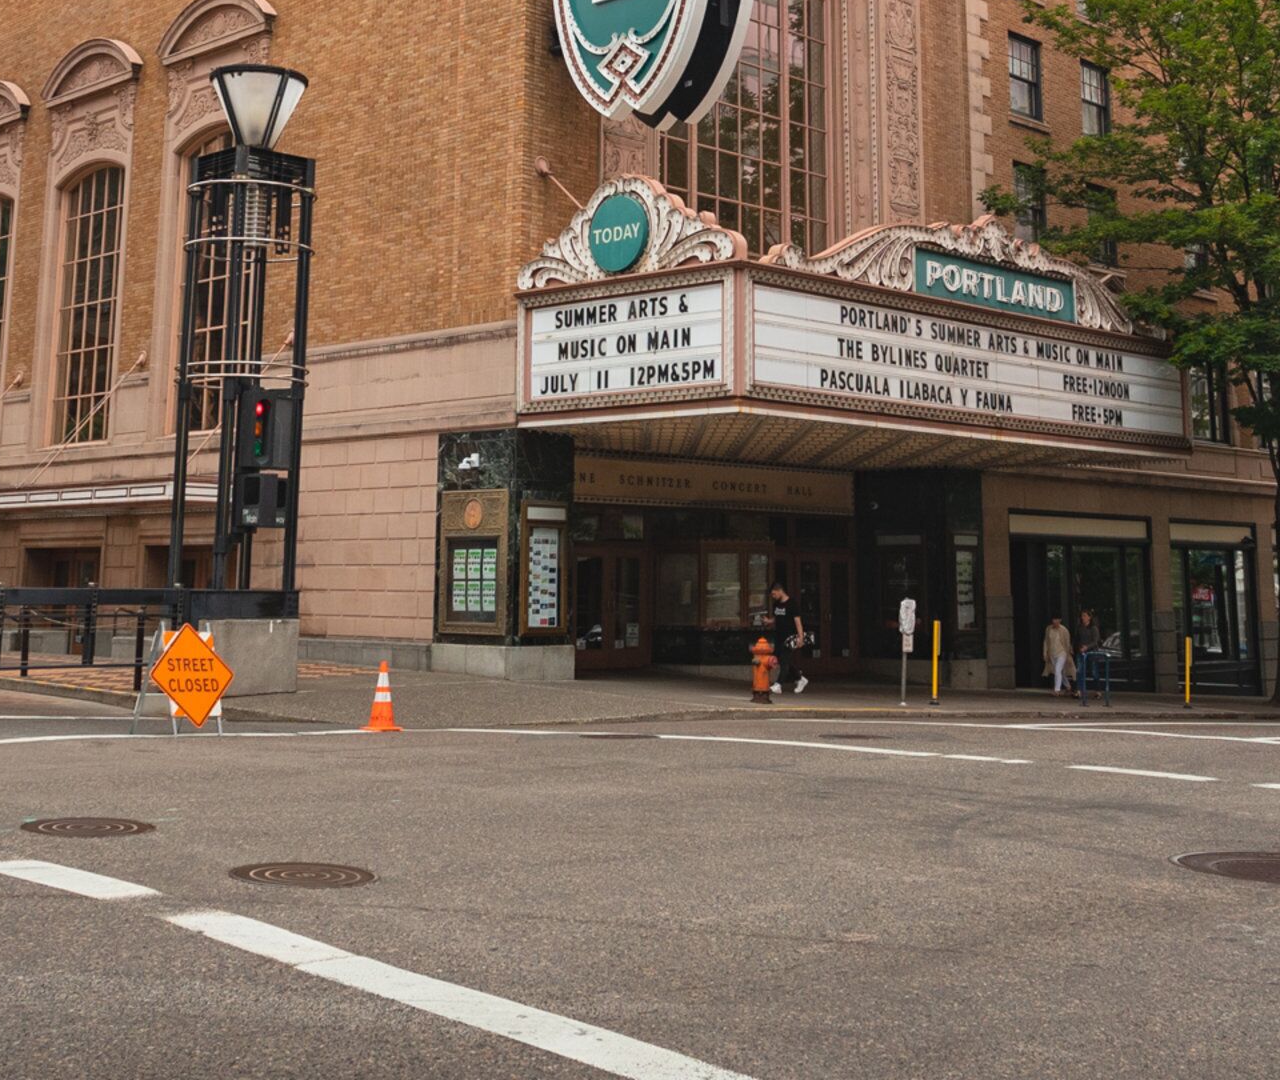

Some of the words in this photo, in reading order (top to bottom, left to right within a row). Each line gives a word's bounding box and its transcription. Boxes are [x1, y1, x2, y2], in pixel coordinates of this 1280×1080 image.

[593, 222, 640, 245] TODAY
[926, 260, 1064, 313] PORTLAND
[555, 304, 617, 329] SUMMER
[627, 297, 668, 321] ARTS
[678, 294, 689, 313] &
[558, 336, 607, 360] MUSIC
[616, 334, 637, 354] ON
[647, 327, 691, 350] MAIN
[837, 338, 863, 359] THE
[872, 343, 927, 369] BYLINES
[935, 354, 989, 379] QUARTET
[930, 322, 981, 347] SUMMER
[988, 333, 1017, 354] ARTS
[1023, 340, 1029, 354] &
[1036, 342, 1071, 363] MUSIC
[1076, 348, 1090, 365] ON
[1096, 352, 1123, 371] MAIN
[540, 373, 579, 395] JULY
[597, 370, 609, 389] 11
[630, 359, 715, 386] 12PM&5PM
[820, 368, 890, 396] PASCUALA
[900, 380, 953, 405] ILABACA
[960, 389, 968, 406] Y
[976, 391, 1013, 413] FAUNA
[620, 475, 691, 489] SCHNITZER
[712, 481, 767, 494] CONCERT
[787, 486, 813, 497] HALL
[167, 658, 214, 672] STREET
[168, 678, 219, 692] CLOSED
